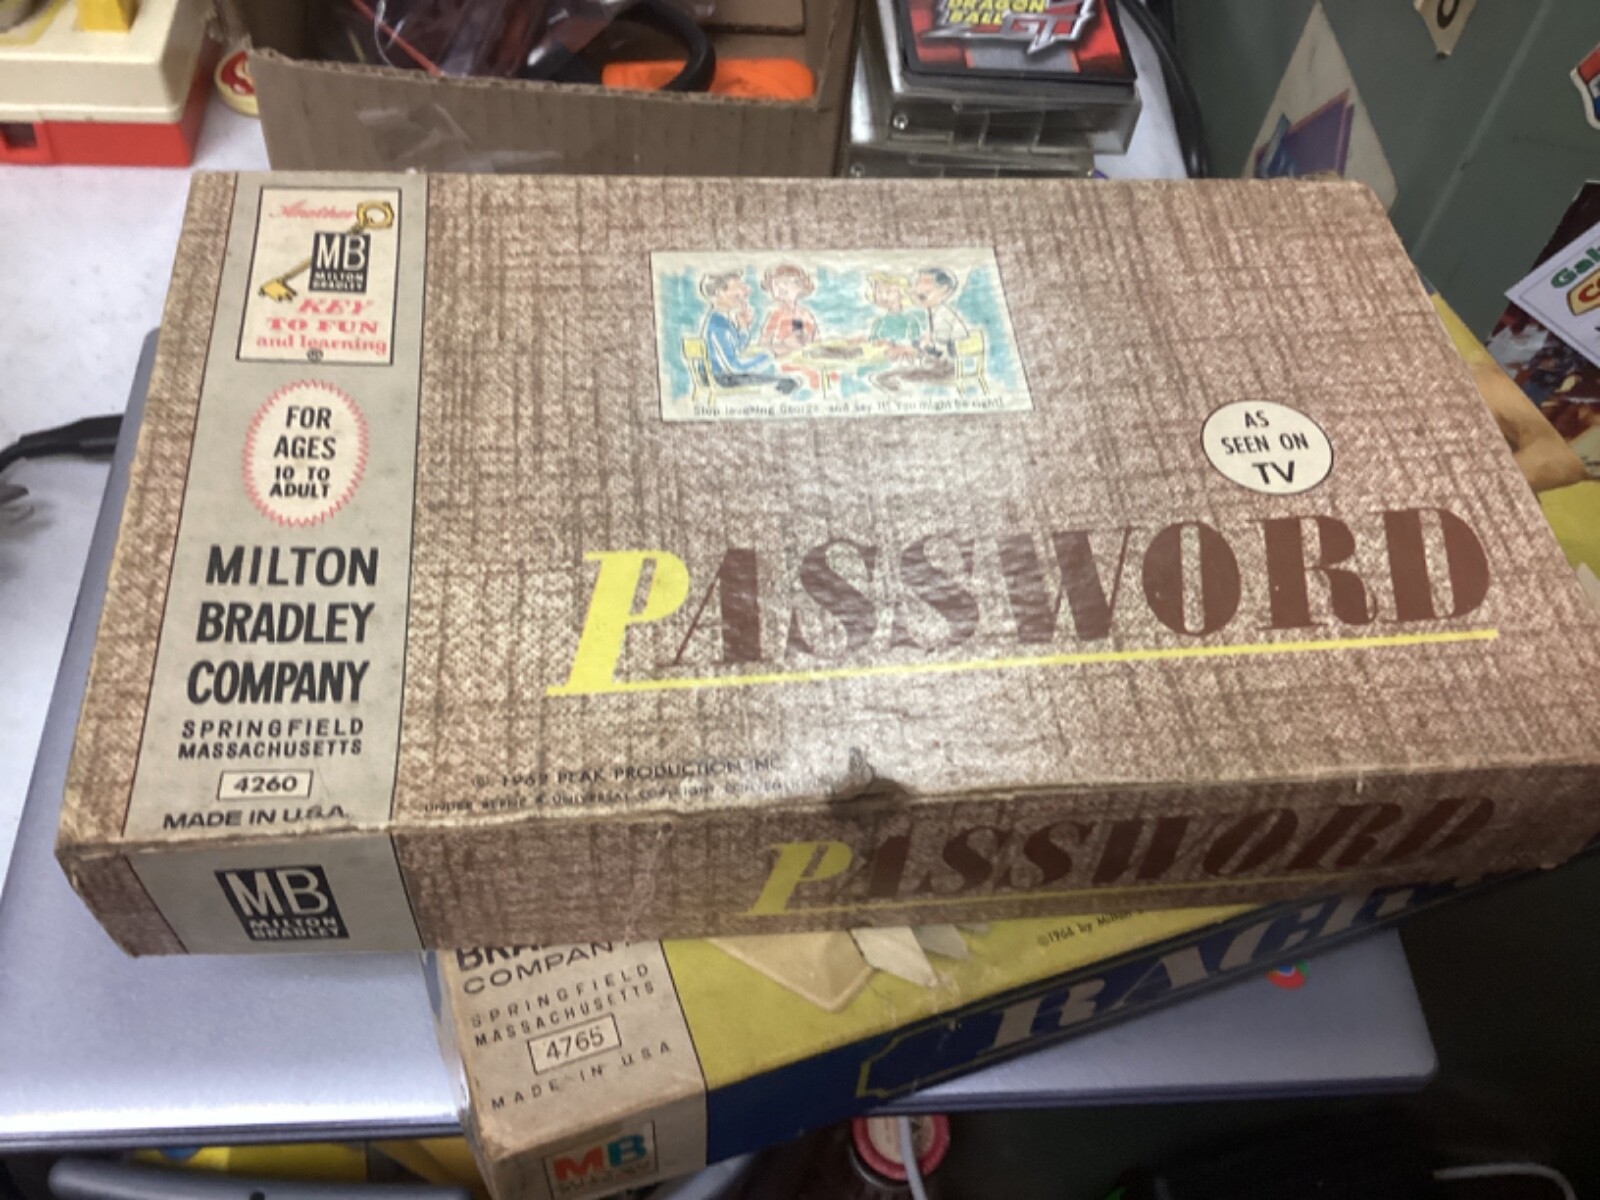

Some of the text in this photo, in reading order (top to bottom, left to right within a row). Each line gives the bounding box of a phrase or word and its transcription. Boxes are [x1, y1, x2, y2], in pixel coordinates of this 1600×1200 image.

[949, 11, 1003, 25] BALL
[317, 233, 366, 271] MB
[1550, 245, 1600, 289] Gal
[297, 298, 373, 315] KEY
[268, 318, 378, 334] TO FUN
[257, 335, 293, 349] and
[301, 335, 387, 356] learning
[286, 405, 332, 429] FOR
[1244, 411, 1270, 427] AS
[273, 435, 336, 460] AGES
[1221, 432, 1309, 455] SEEN ON
[275, 466, 330, 481] 10 TO
[1252, 461, 1295, 485] TV
[269, 483, 330, 498] ADULT
[205, 545, 379, 587] MILTON
[546, 507, 1491, 697] PASSWORD
[196, 602, 375, 643] BRADLEY
[187, 660, 370, 704] COMPANY
[181, 718, 364, 739] SPRINGFIELD
[177, 739, 362, 760] MASSACHUSETTS
[233, 776, 298, 793] 4260
[557, 769, 603, 784] PEAK
[163, 810, 243, 830] MADE
[249, 808, 276, 825] IN
[748, 797, 1496, 917] PASSWORD
[224, 870, 331, 917] MB
[249, 916, 338, 929] MILTON
[252, 926, 339, 938] BRADLEY
[463, 941, 631, 995] COMPAN
[471, 963, 649, 1028] SPRINGFIELD
[475, 981, 655, 1047] MASSACHUSETTS
[546, 1029, 605, 1060] 4765
[491, 1078, 560, 1110] MADE
[579, 1063, 605, 1082] IN
[552, 1134, 648, 1182] MB
